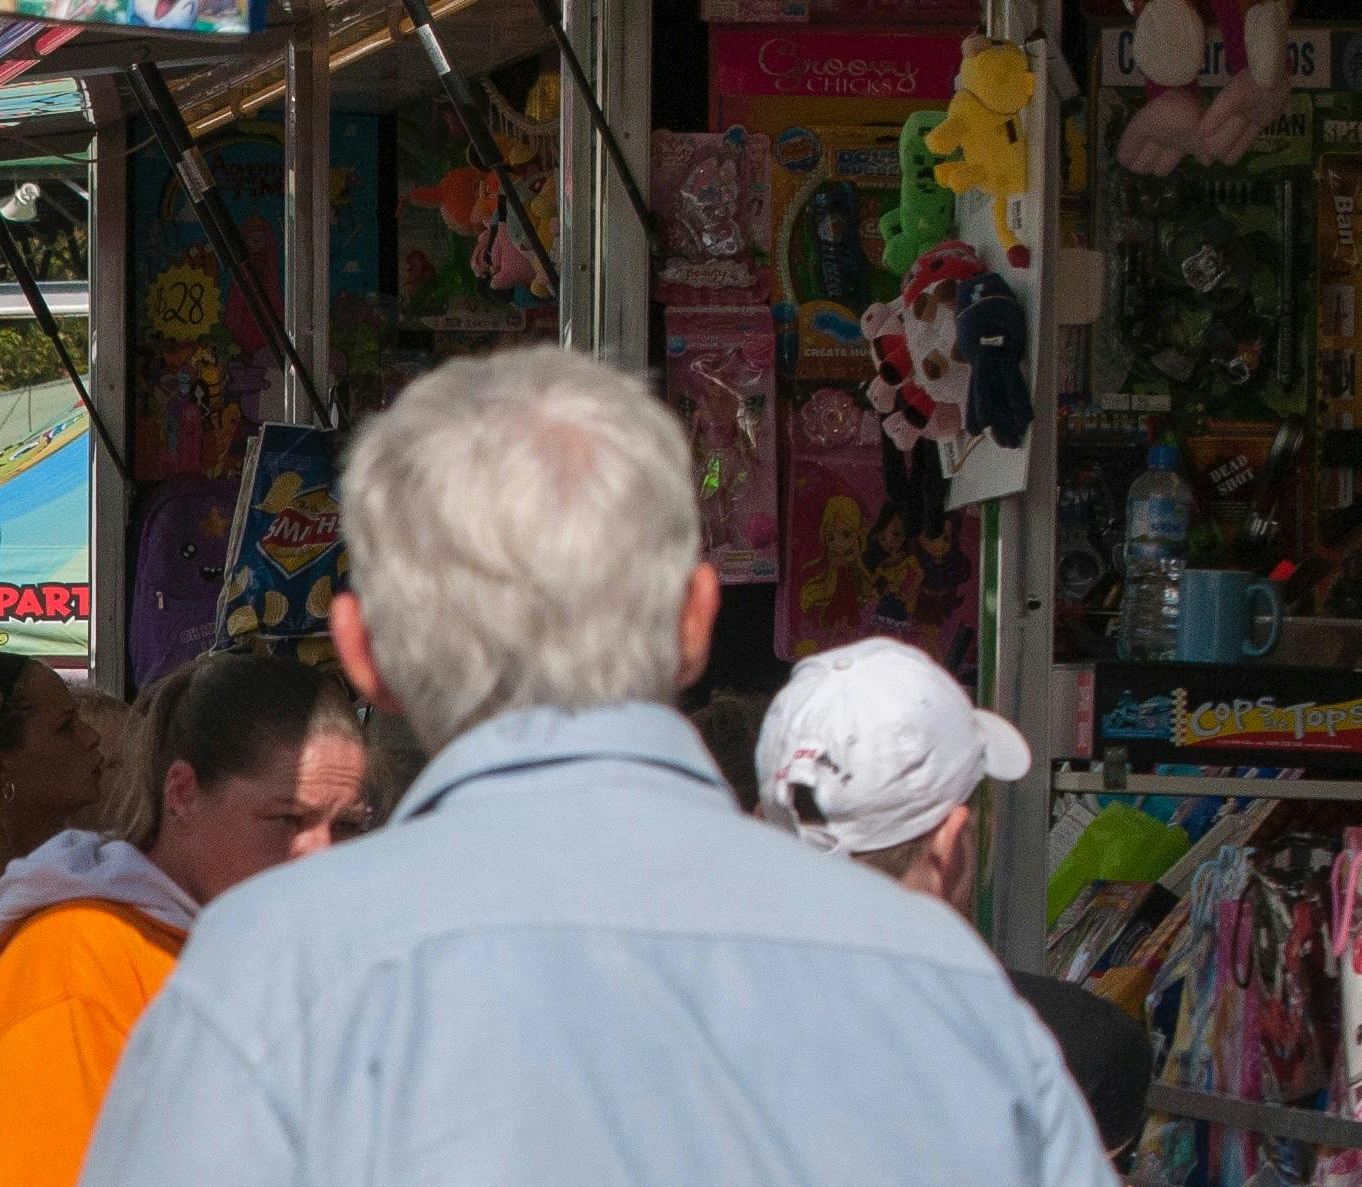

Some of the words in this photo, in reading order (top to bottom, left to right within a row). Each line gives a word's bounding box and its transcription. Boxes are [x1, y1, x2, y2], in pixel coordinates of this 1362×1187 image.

[758, 37, 920, 93] Groovy
[806, 76, 892, 94] CHICKS
[1209, 454, 1249, 483] DEAD
[1216, 466, 1255, 497] SHOT
